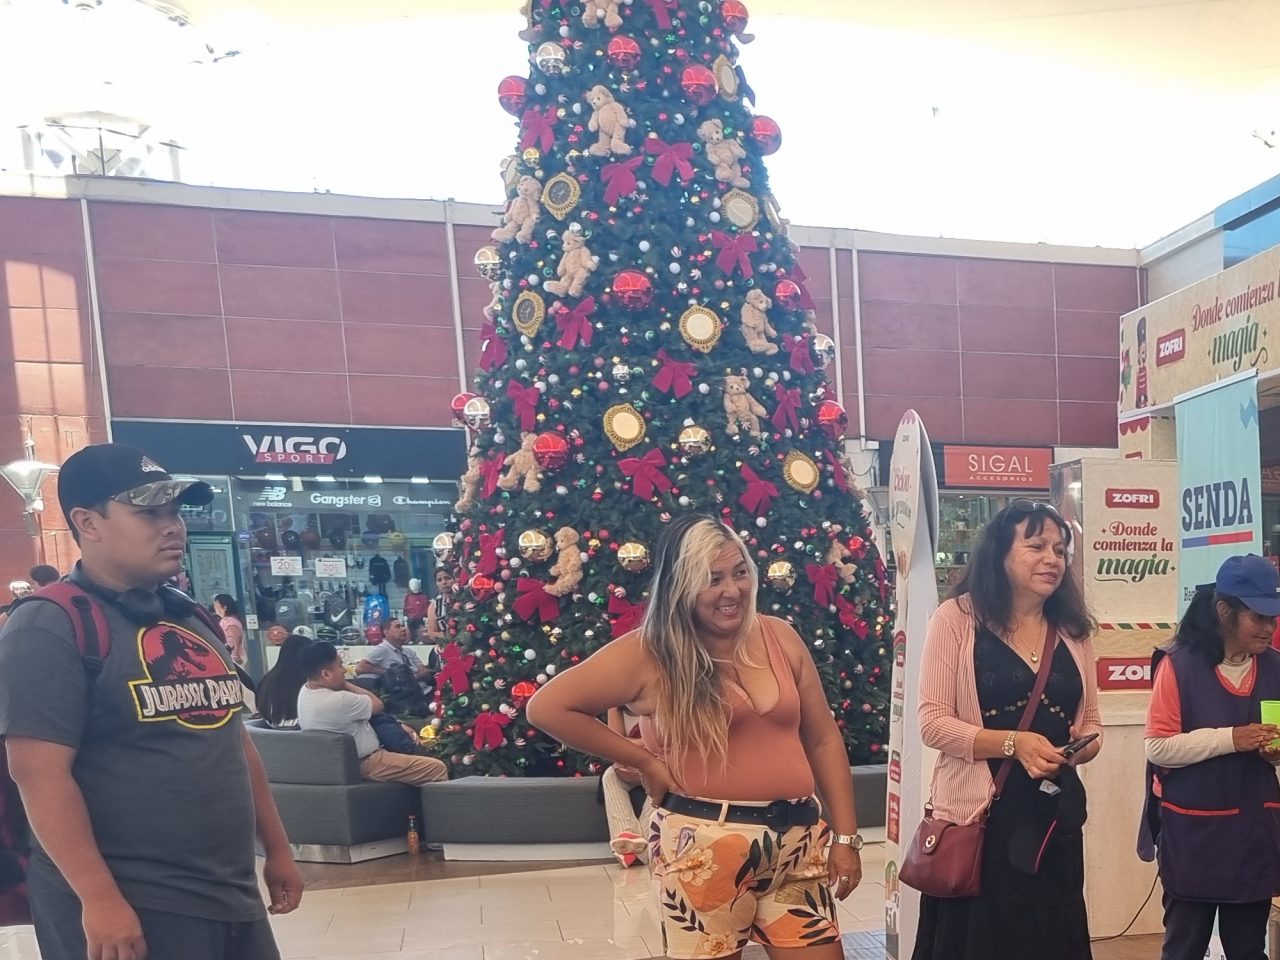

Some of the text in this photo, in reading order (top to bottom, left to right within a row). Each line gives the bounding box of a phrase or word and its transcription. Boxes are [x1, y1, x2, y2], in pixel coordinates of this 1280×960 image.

[1191, 296, 1223, 332] Donde
[1225, 280, 1275, 319] comienza
[1158, 336, 1183, 358] ZOFRI
[1212, 315, 1260, 372] magia
[242, 434, 347, 460] VIGO
[263, 453, 327, 463] SPORT
[968, 454, 1034, 473] SIGAL
[310, 493, 367, 508] Gangster
[392, 496, 451, 508] Champion
[1112, 493, 1154, 504] ZOFRI
[1181, 477, 1253, 532] SENDA
[1109, 521, 1158, 537] Donde
[1093, 538, 1174, 552] comienza la
[1097, 553, 1170, 583] magia
